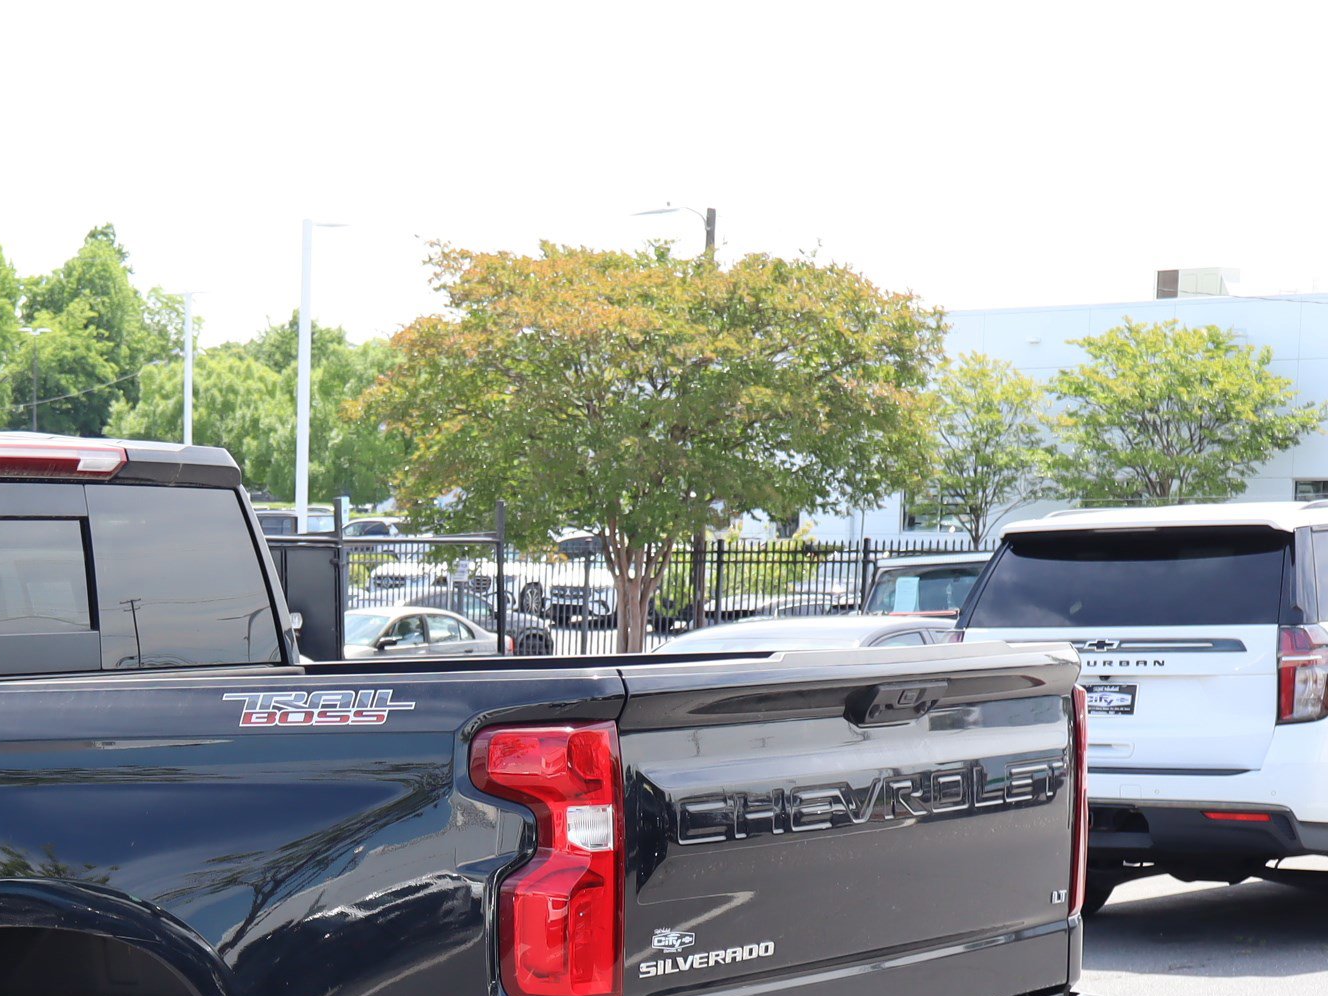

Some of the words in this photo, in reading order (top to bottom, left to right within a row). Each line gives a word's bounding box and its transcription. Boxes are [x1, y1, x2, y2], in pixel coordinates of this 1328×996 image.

[1086, 659, 1165, 667] URBAN
[223, 689, 416, 710] TRAIL
[239, 709, 389, 727] BOSS
[677, 758, 1065, 846] CHEVROLET
[1051, 889, 1068, 904] LT
[638, 941, 775, 979] SILVERADO
